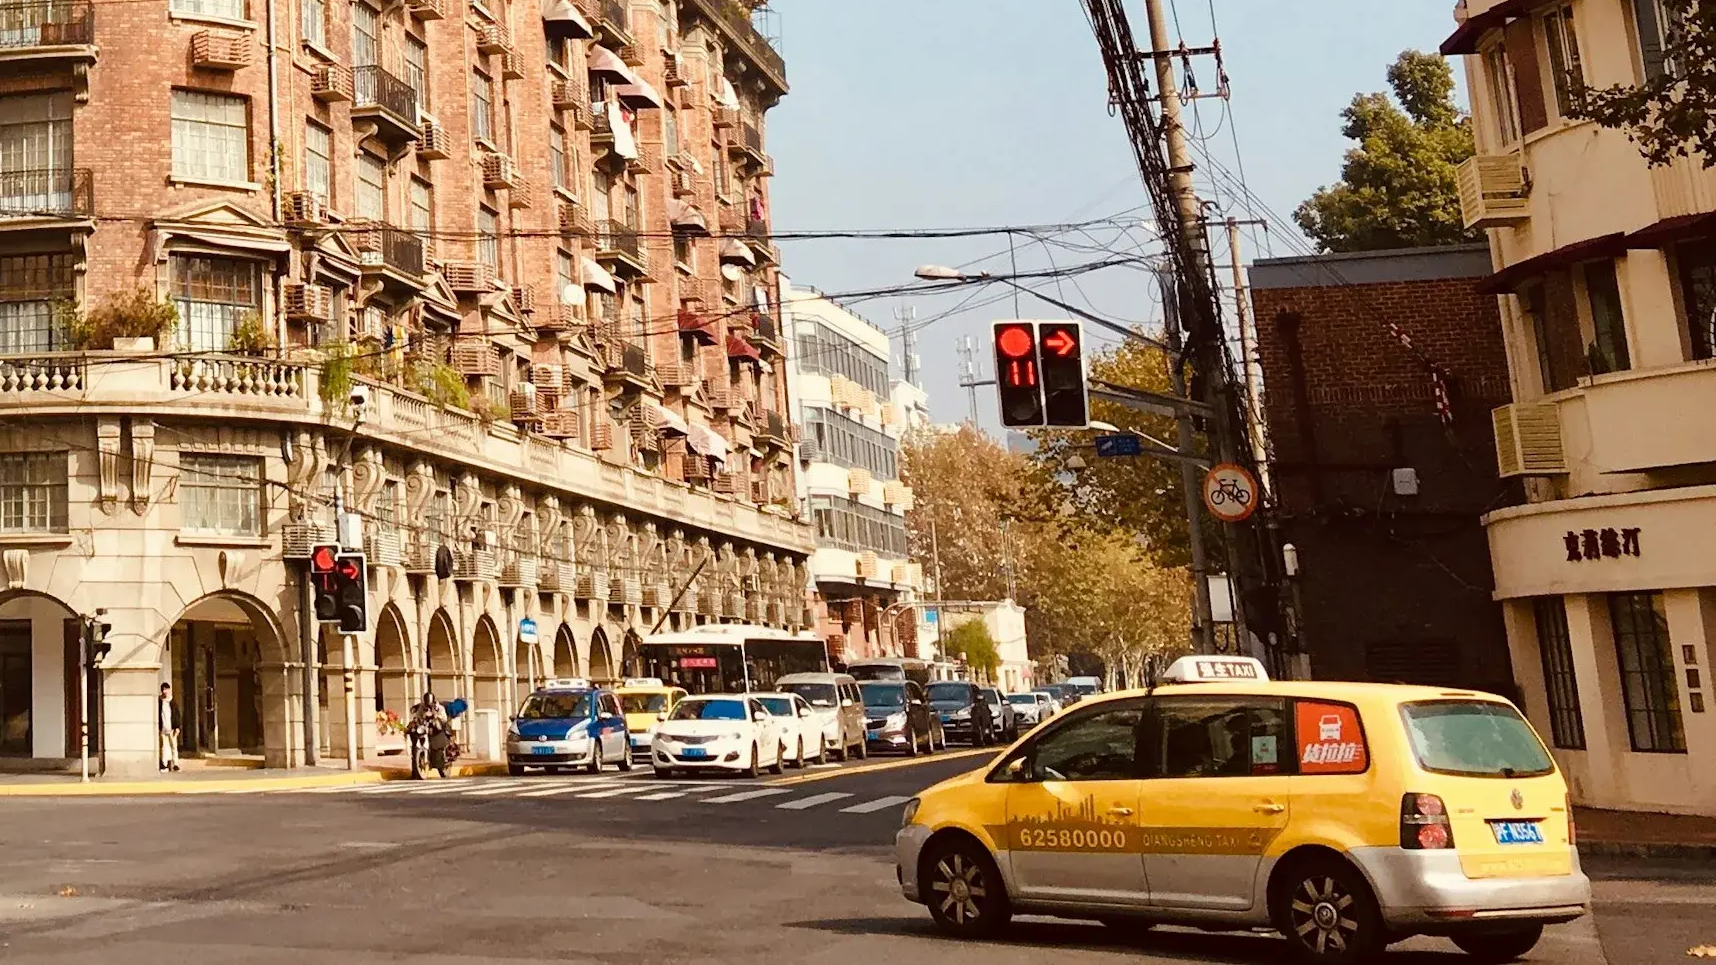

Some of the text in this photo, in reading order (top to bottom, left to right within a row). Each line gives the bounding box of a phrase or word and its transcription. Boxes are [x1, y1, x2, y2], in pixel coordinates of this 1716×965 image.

[1020, 828, 1126, 848] 62580000
[1142, 835, 1241, 848] QIANGSHENG TAXI
